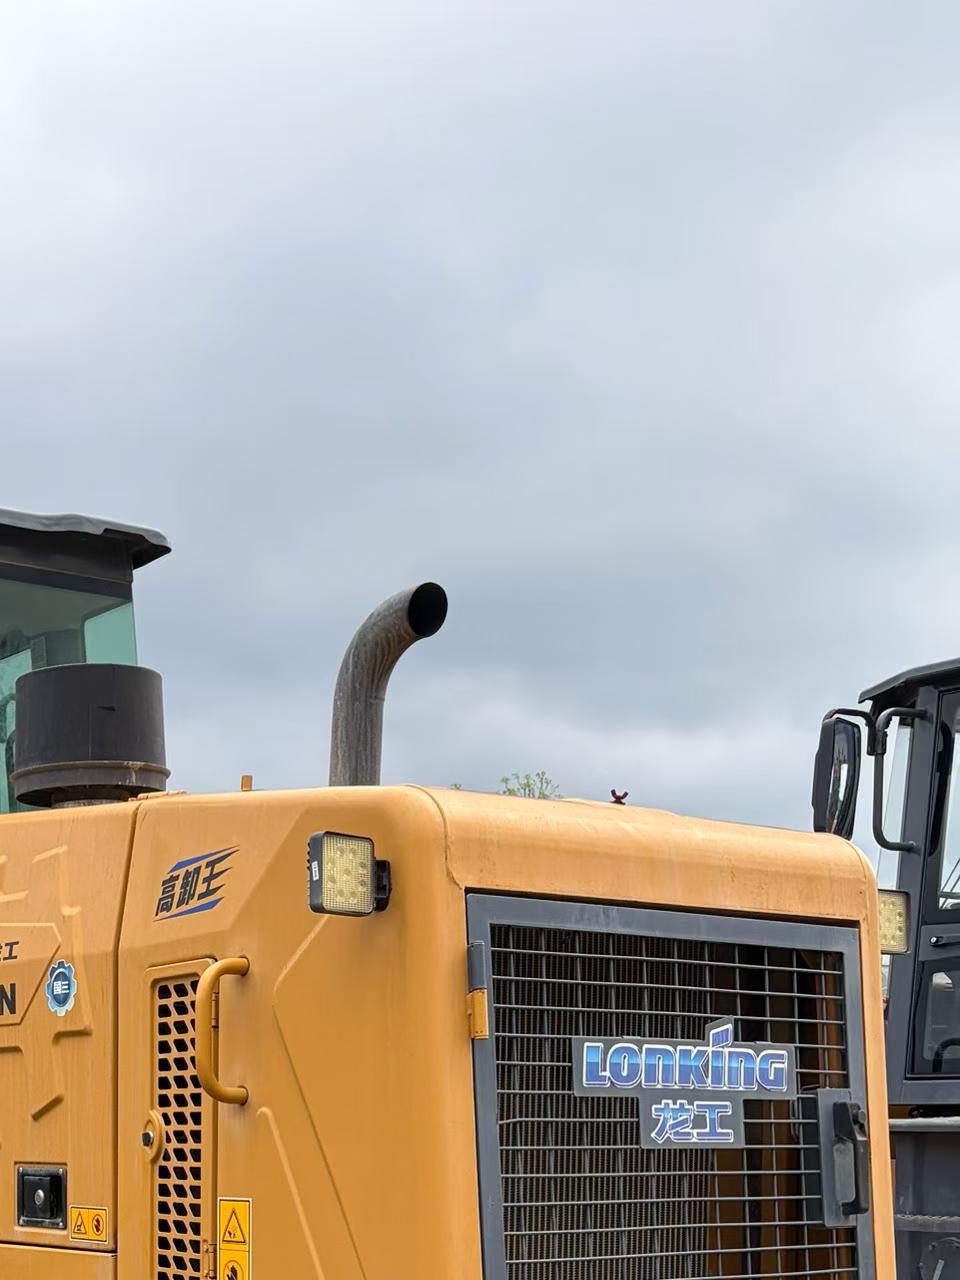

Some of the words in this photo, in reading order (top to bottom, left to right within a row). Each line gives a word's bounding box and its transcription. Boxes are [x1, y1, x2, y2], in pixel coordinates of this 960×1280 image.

[155, 849, 240, 916] 高卸王
[583, 1023, 788, 1092] LONKING
[651, 1100, 734, 1144] 龙工
